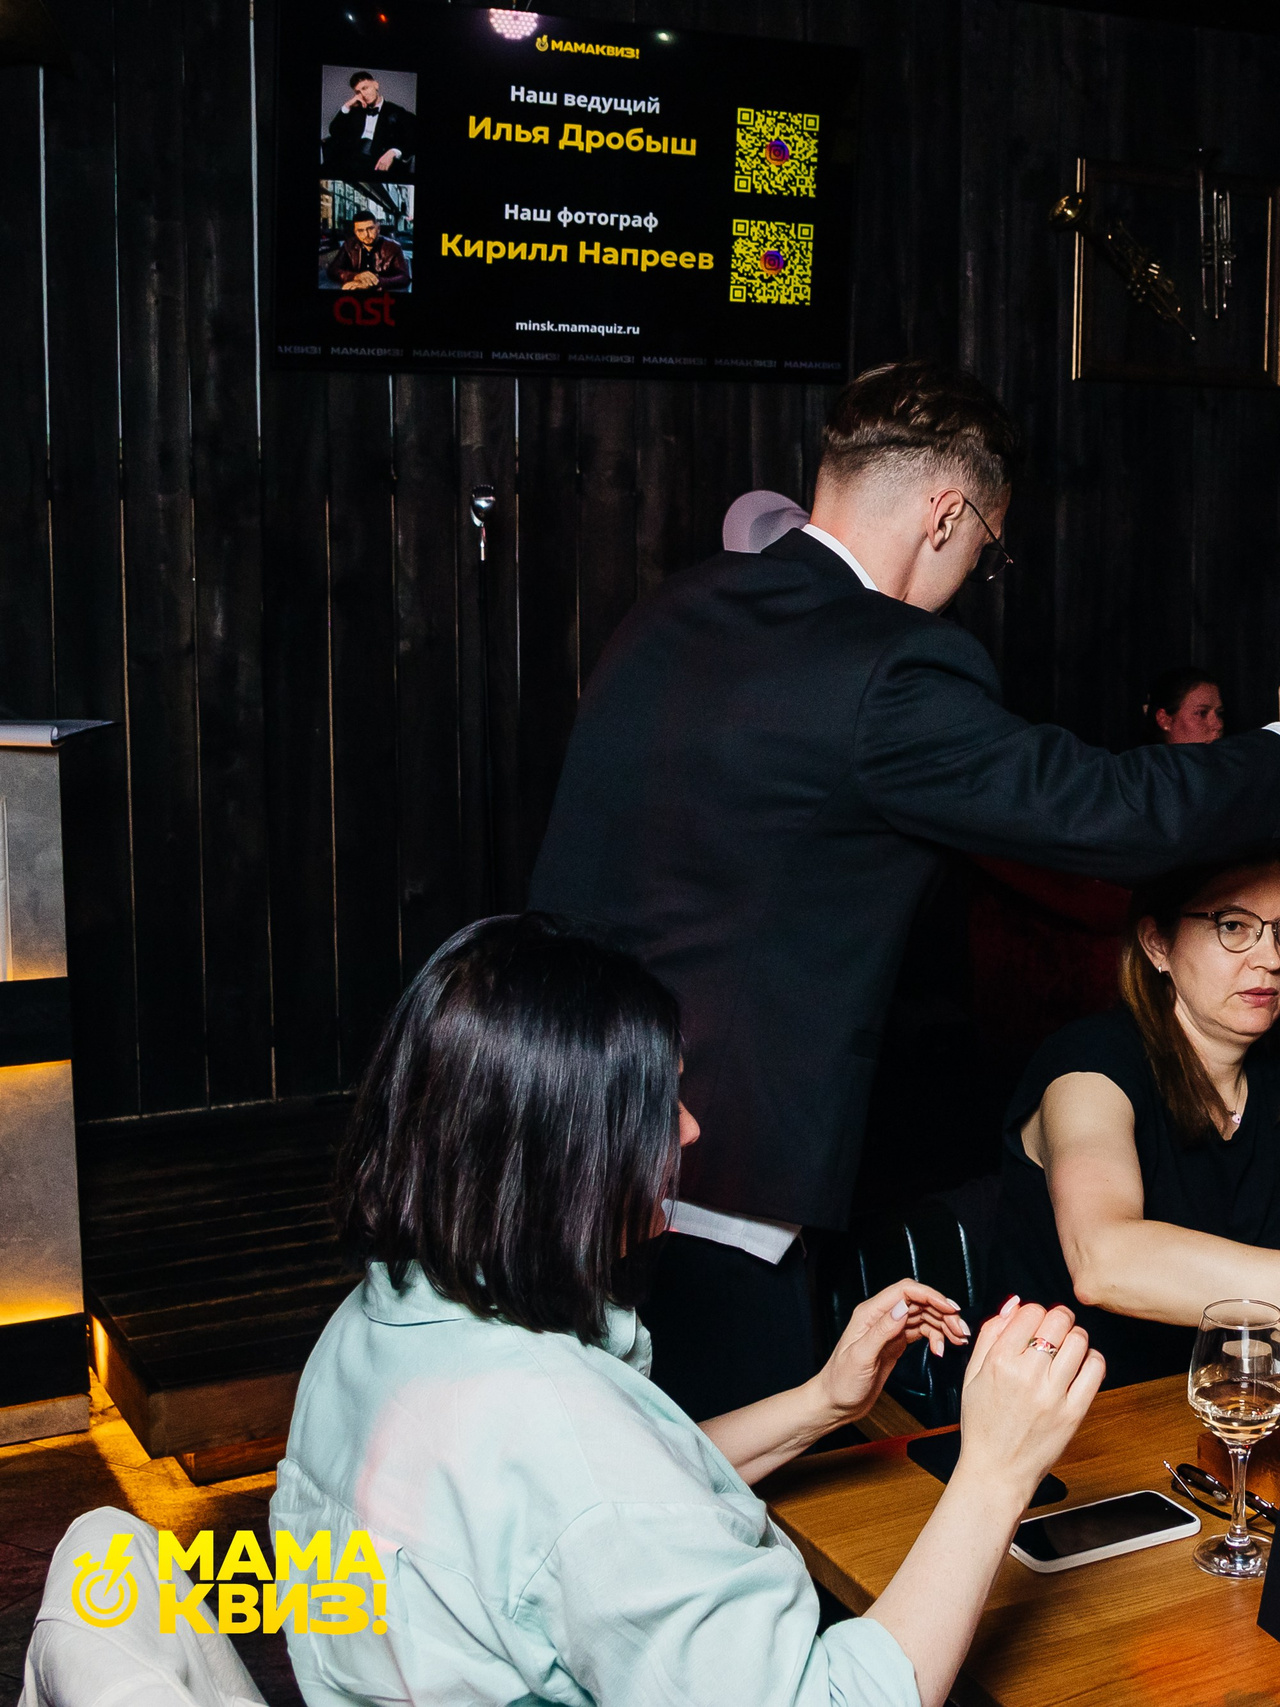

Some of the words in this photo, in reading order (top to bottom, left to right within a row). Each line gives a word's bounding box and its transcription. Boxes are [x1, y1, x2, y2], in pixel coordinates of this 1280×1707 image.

[550, 40, 640, 60] МАМАКВИЗ!
[510, 85, 557, 106] Наш
[563, 92, 661, 116] ведущий
[468, 115, 549, 145] Илья
[558, 122, 697, 157] Дробыш
[504, 203, 552, 223] Наш
[556, 206, 660, 233] фотограф
[441, 232, 569, 265] Кирилл
[578, 240, 715, 273] Напреев
[515, 319, 640, 337] minsk.mamaquiz.ru
